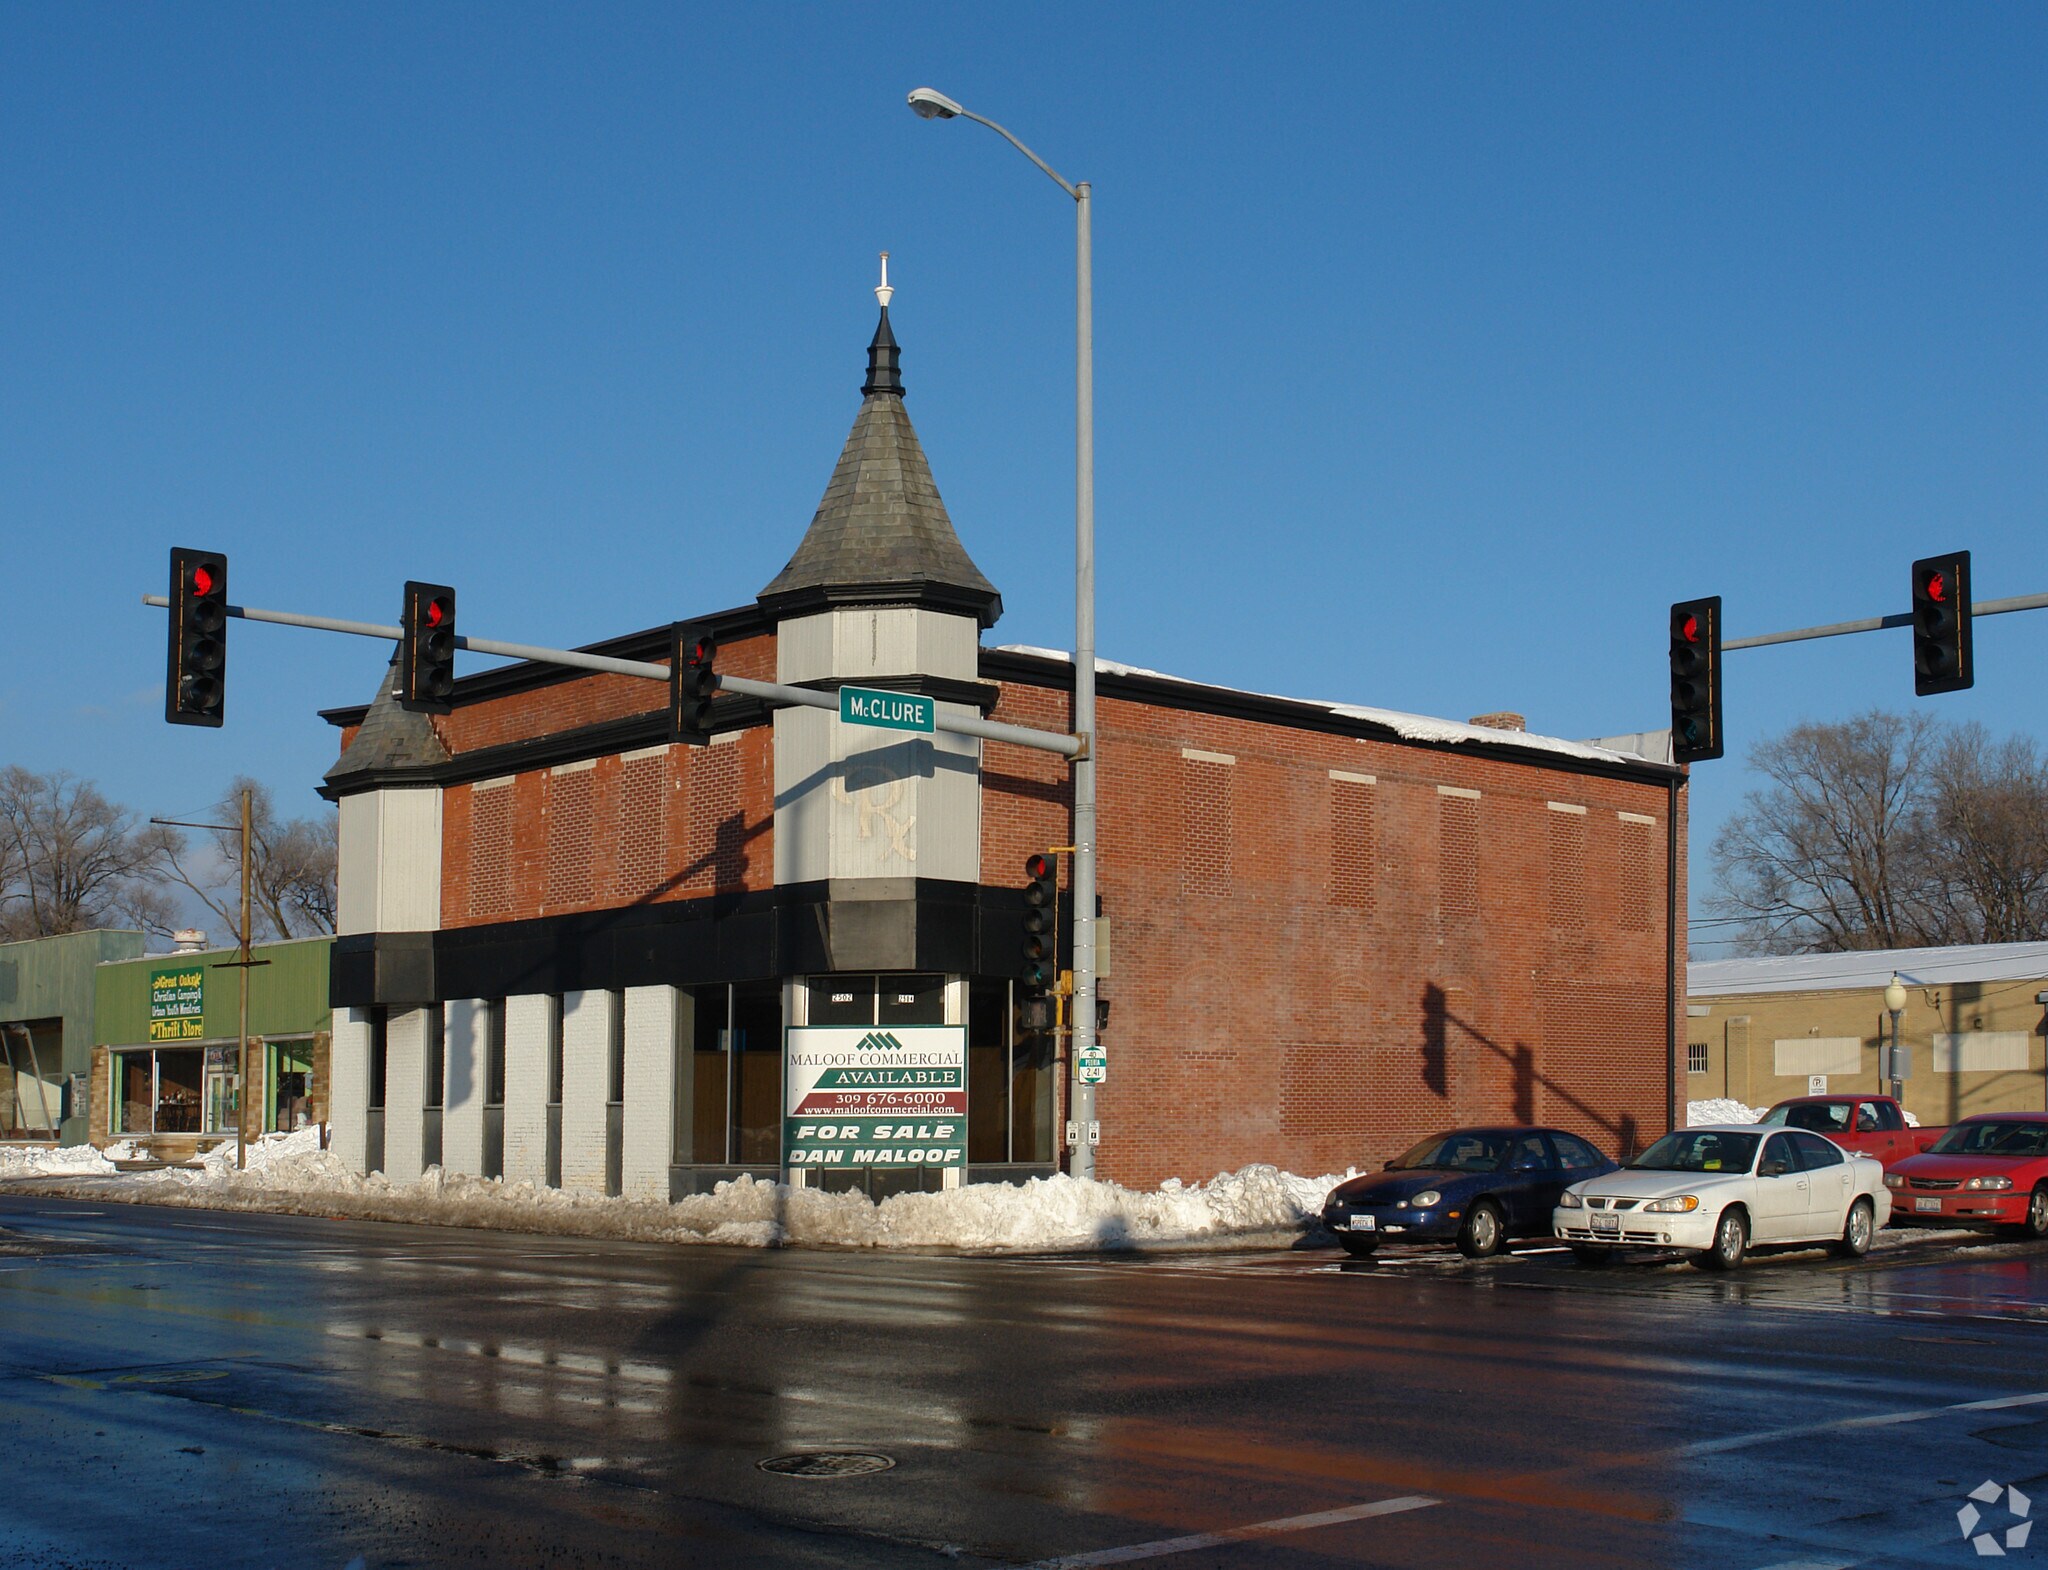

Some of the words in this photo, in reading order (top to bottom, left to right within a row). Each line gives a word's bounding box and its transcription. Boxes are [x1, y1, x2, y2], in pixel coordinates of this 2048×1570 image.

[851, 696, 925, 724] McCLURE
[156, 1021, 180, 1039] Thrift
[182, 1020, 202, 1037] Store
[790, 1053, 855, 1066] MALOOF
[859, 1052, 963, 1065] COMMERCIAL
[835, 1071, 956, 1084] AVAILABLE
[836, 1094, 861, 1104] 309
[866, 1092, 946, 1104] 676-6000
[804, 1104, 955, 1115] www.maloofcommercial.com
[796, 1125, 859, 1139] FOR
[872, 1125, 953, 1139] SALE
[788, 1149, 843, 1163] DAN
[852, 1149, 961, 1163] MALOOF
